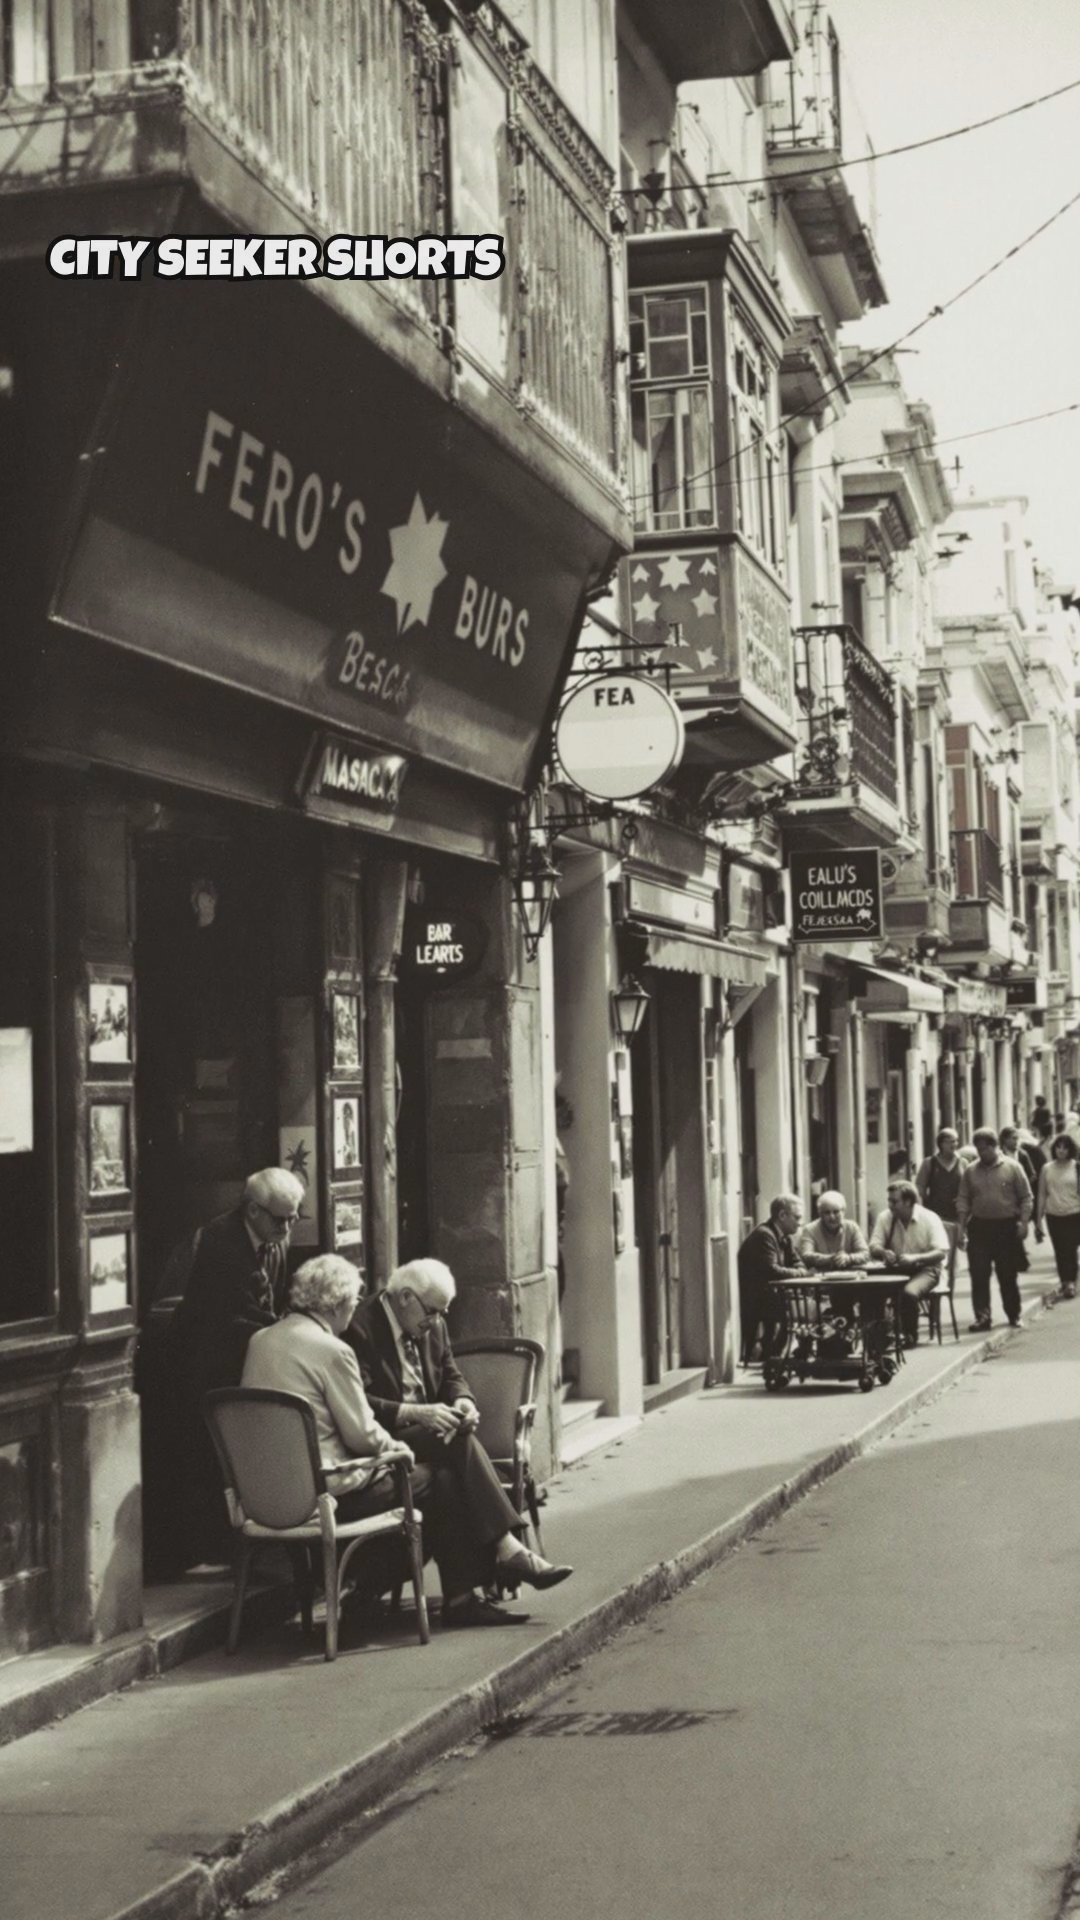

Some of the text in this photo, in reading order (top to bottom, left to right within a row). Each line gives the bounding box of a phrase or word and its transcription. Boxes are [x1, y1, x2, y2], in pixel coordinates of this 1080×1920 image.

[195, 409, 529, 668] FERO'S BURS
[593, 687, 635, 707] FEA
[427, 923, 452, 943] BAR
